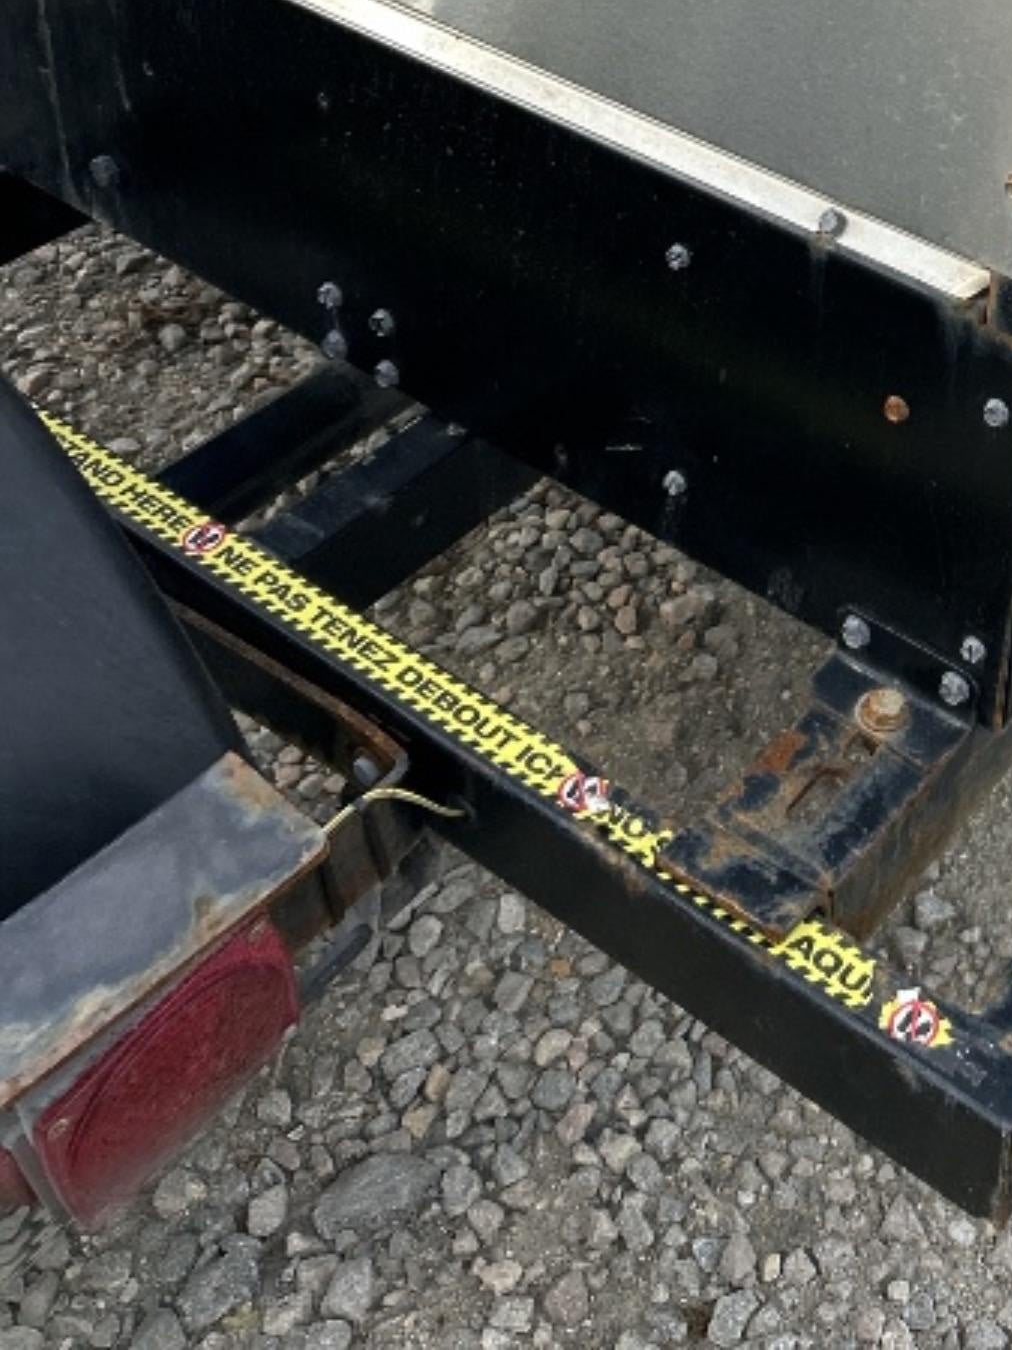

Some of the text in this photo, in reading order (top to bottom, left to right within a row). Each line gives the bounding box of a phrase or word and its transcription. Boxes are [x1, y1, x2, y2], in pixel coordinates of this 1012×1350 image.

[119, 478, 193, 531] HERE
[216, 546, 258, 575] NE
[254, 571, 311, 611] PAS
[310, 605, 401, 672] TENEZ
[395, 665, 521, 754] DEBOUT
